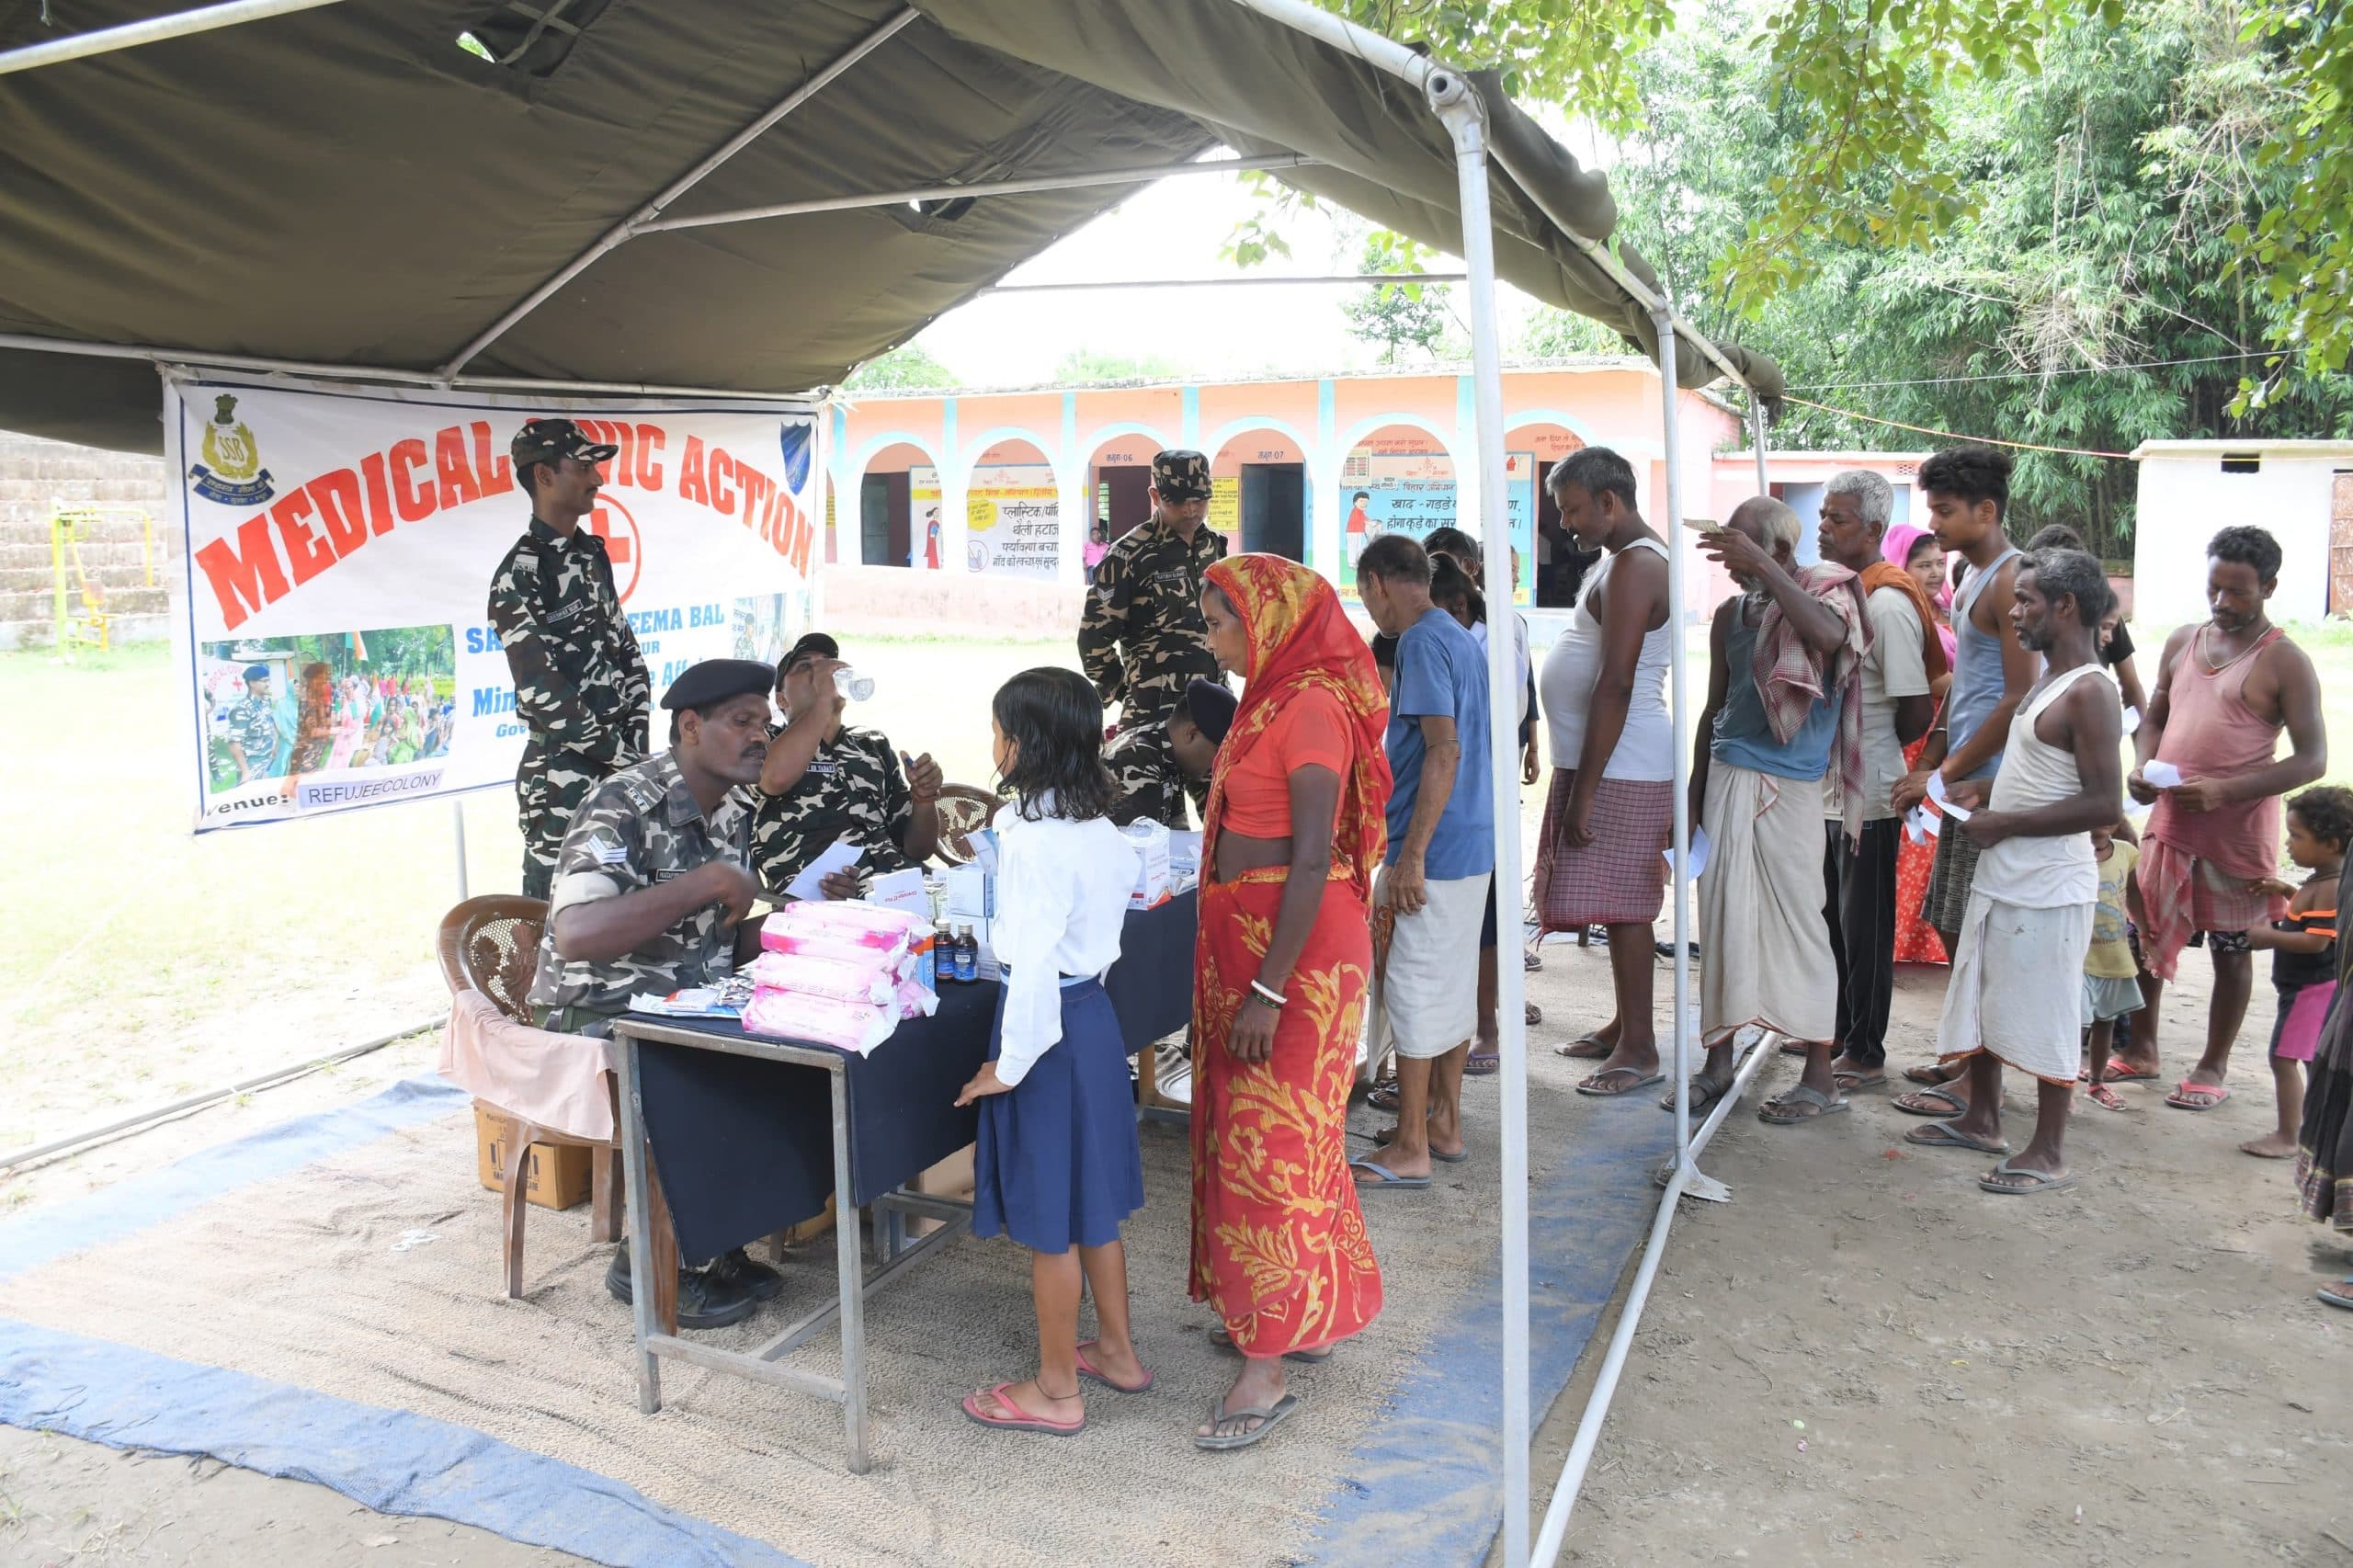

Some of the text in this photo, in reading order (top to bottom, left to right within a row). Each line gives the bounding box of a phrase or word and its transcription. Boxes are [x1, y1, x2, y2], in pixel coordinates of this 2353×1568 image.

[217, 435, 245, 462] SSB
[1274, 450, 1284, 460] 07
[1391, 499, 1416, 510] खाद
[194, 418, 813, 631] MEDICAL VIC ACTION
[627, 610, 683, 635] EEMA
[689, 603, 725, 629] BAL
[308, 774, 440, 804] REFUJEECOLONY
